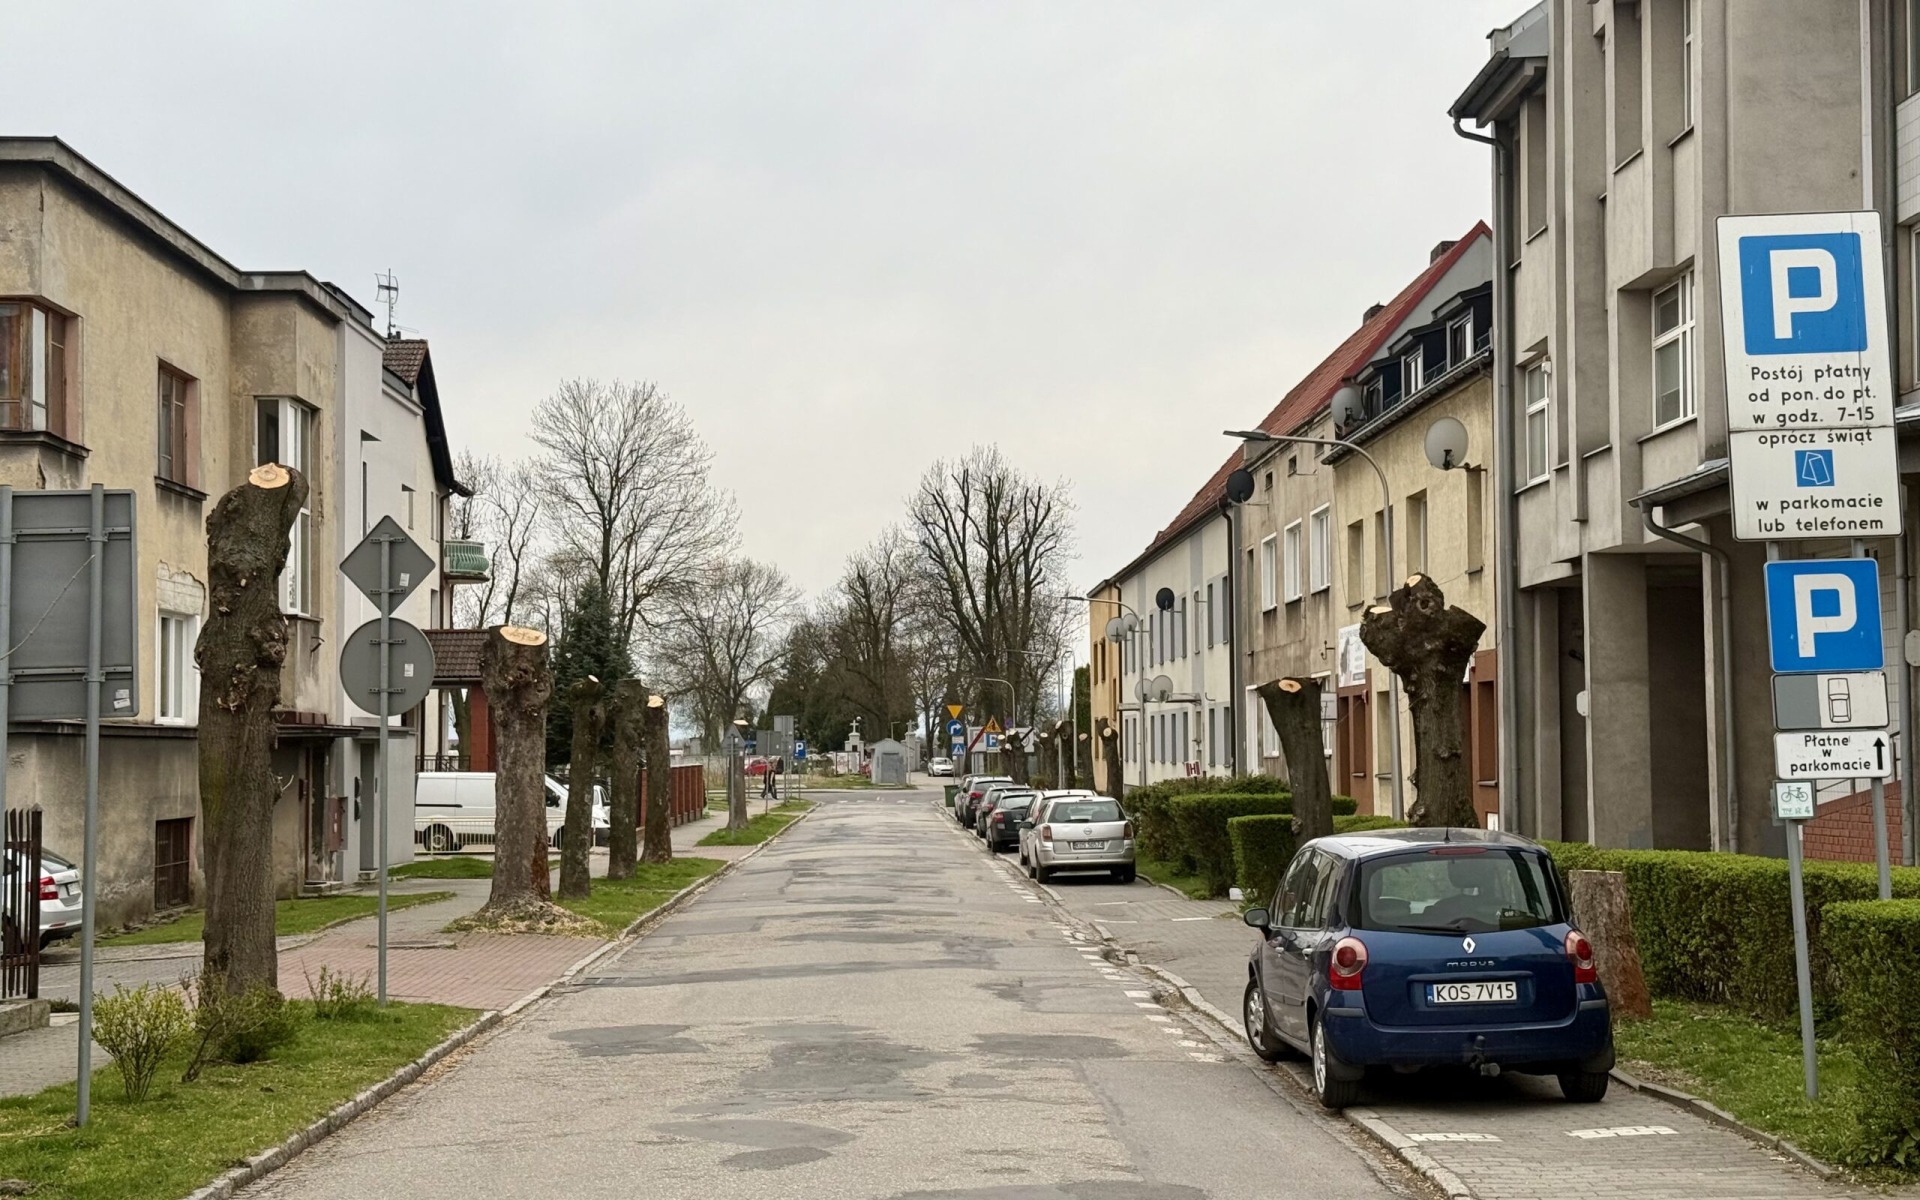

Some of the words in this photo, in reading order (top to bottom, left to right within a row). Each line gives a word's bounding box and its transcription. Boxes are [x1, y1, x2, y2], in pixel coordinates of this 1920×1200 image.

[1769, 248, 1839, 340] P
[1751, 366, 1803, 383] Postój
[1814, 364, 1871, 383] płatny
[1748, 388, 1769, 403] od
[1781, 390, 1819, 405] pon.
[1824, 386, 1845, 400] do
[1853, 386, 1876, 403] pt.
[1752, 413, 1766, 425] w
[1776, 409, 1824, 427] godz.
[1837, 406, 1875, 422] 7-15
[1758, 429, 1816, 448] oprócz
[1827, 427, 1873, 446] świąt
[1756, 500, 1769, 511] w
[1780, 494, 1883, 514] parkomacie
[1758, 518, 1785, 533] lub
[1796, 517, 1884, 531] telefonem
[1793, 573, 1858, 657] P
[796, 742, 804, 753] P
[1804, 735, 1850, 747] Płatne
[1821, 748, 1832, 758] w
[1790, 759, 1871, 776] parkomacie
[1436, 985, 1471, 1001] KOS
[1475, 984, 1514, 1000] 7V15
